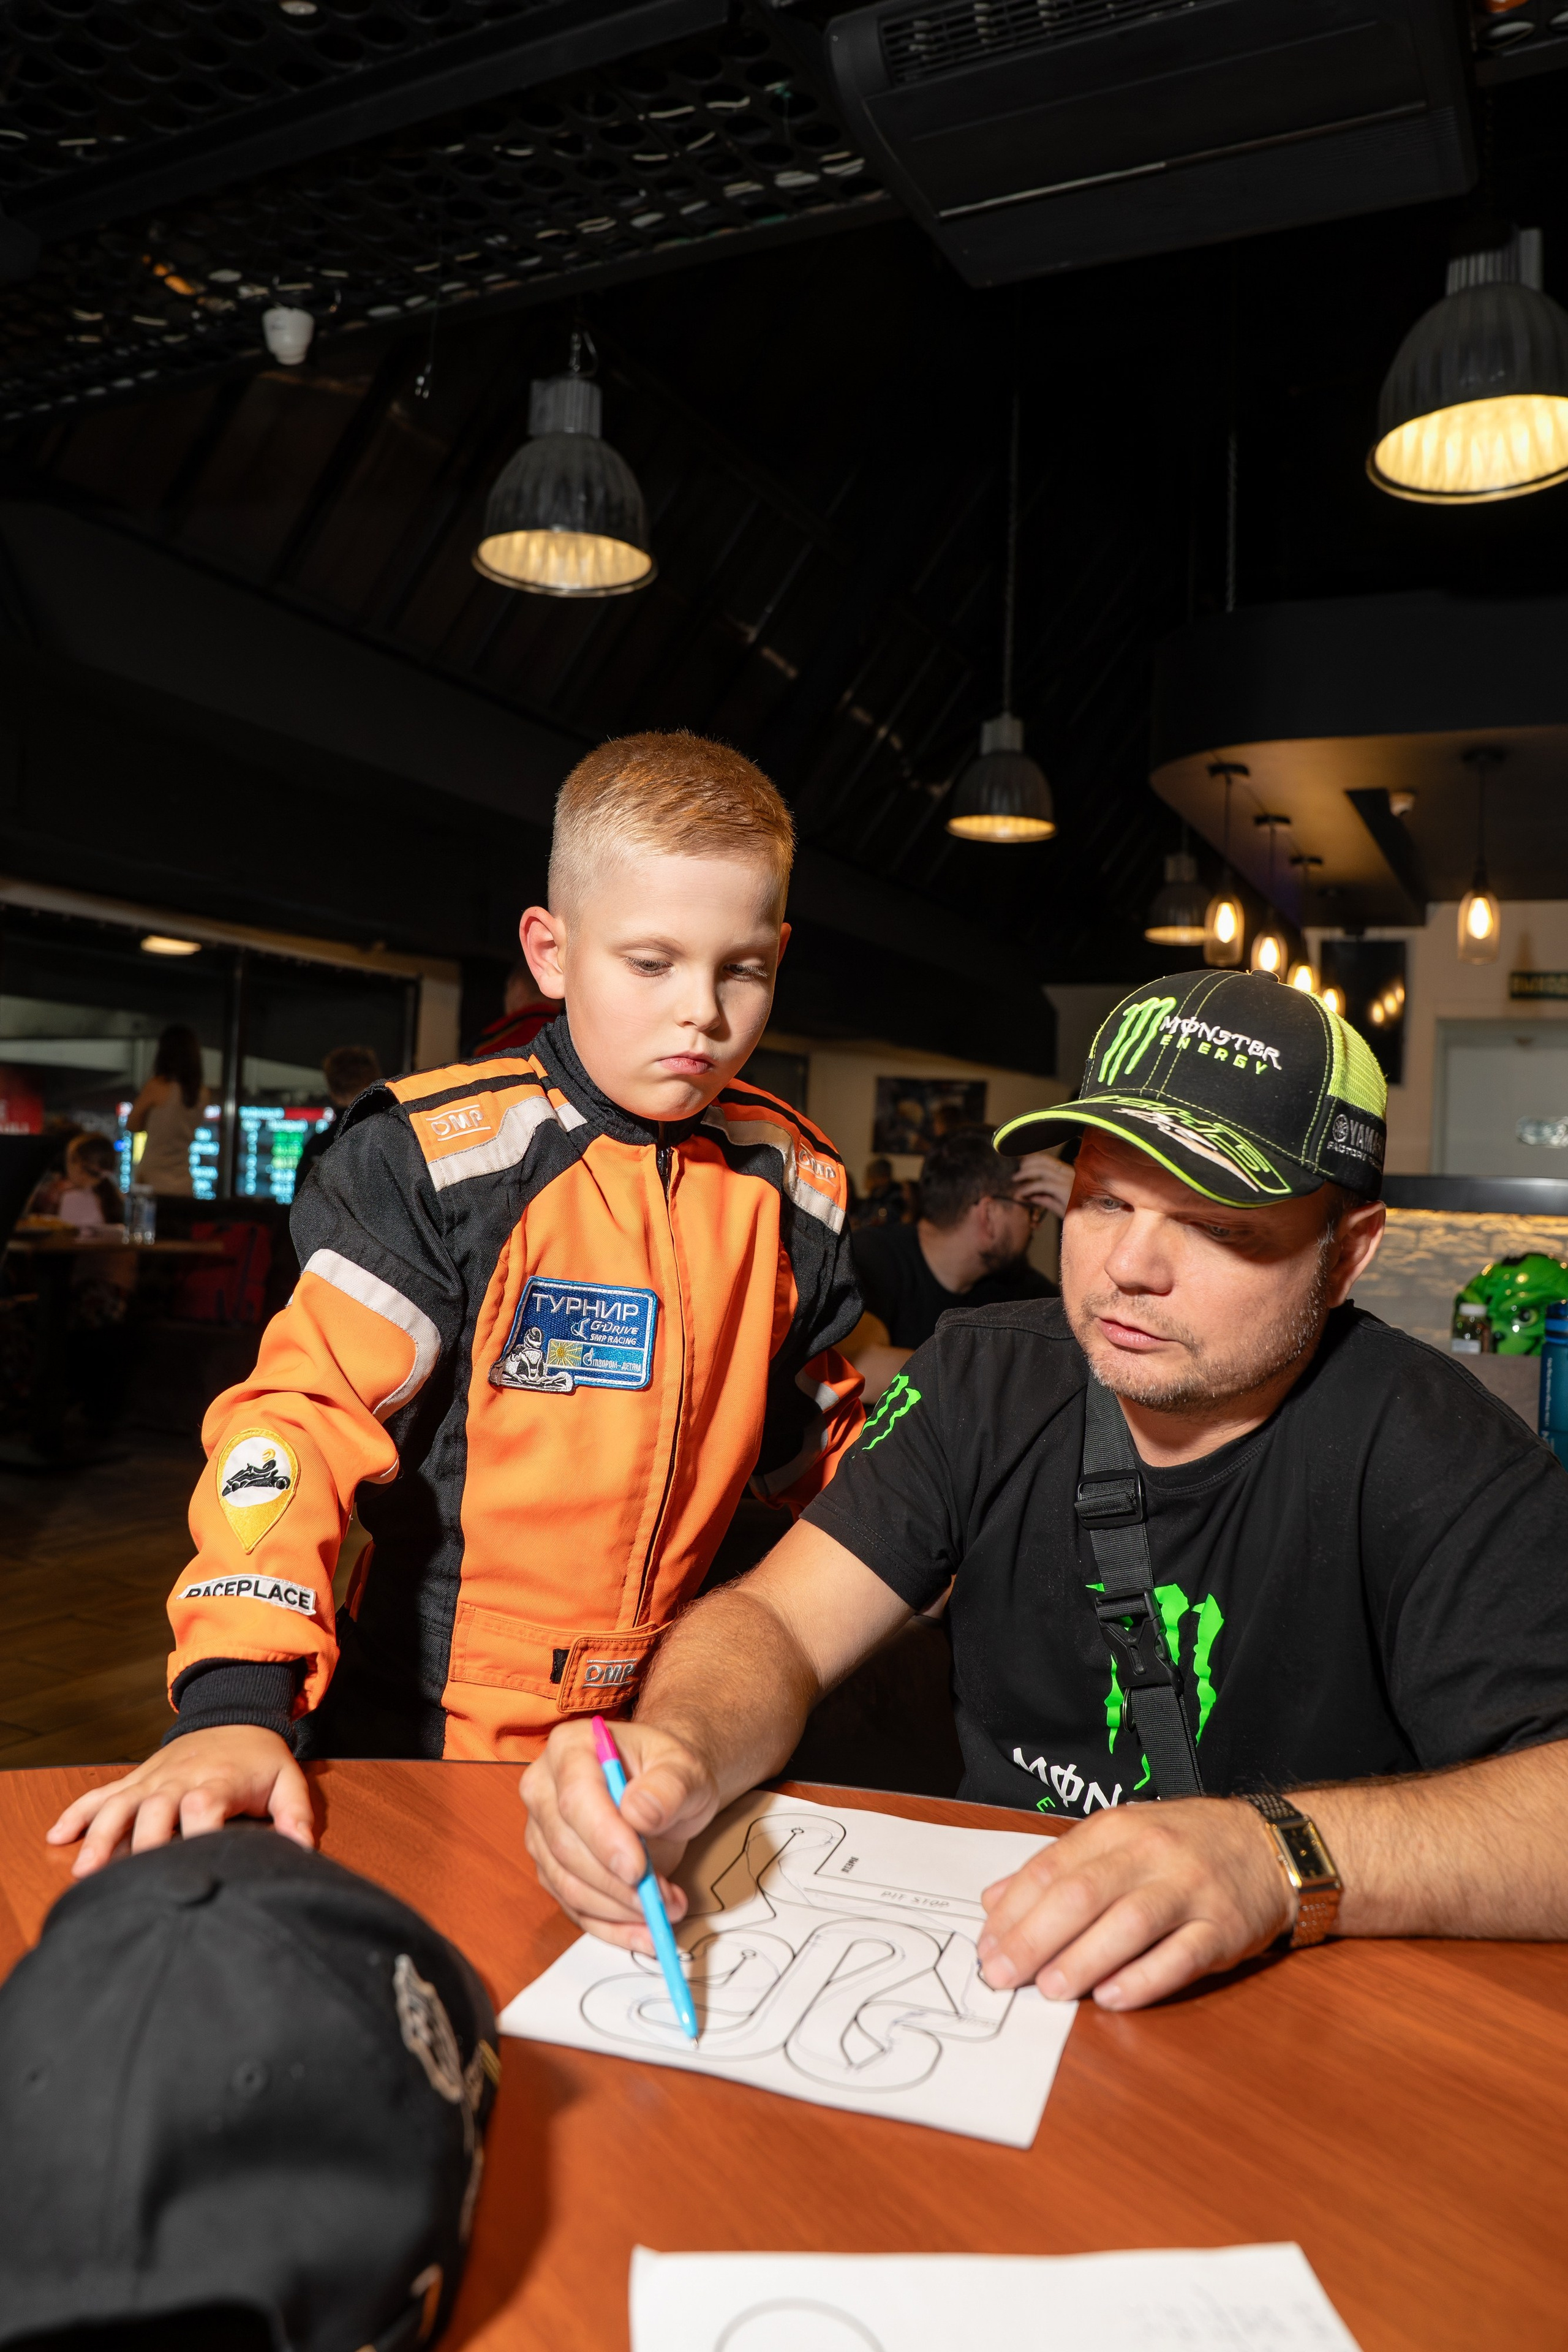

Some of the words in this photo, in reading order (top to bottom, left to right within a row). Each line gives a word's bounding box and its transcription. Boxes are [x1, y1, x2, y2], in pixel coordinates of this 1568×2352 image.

[1159, 1034, 1268, 1075] ENERGY
[431, 1110, 483, 1136] OMP
[799, 1149, 836, 1178] OMP
[532, 1292, 639, 1322] ТУРНИР
[589, 1333, 606, 1342] SMP
[608, 1335, 637, 1346] RACING
[185, 1579, 311, 1610] RACEPLACE
[585, 1663, 635, 1684] OMP
[881, 1890, 907, 1902] PIT
[913, 1896, 949, 1909] STOP
